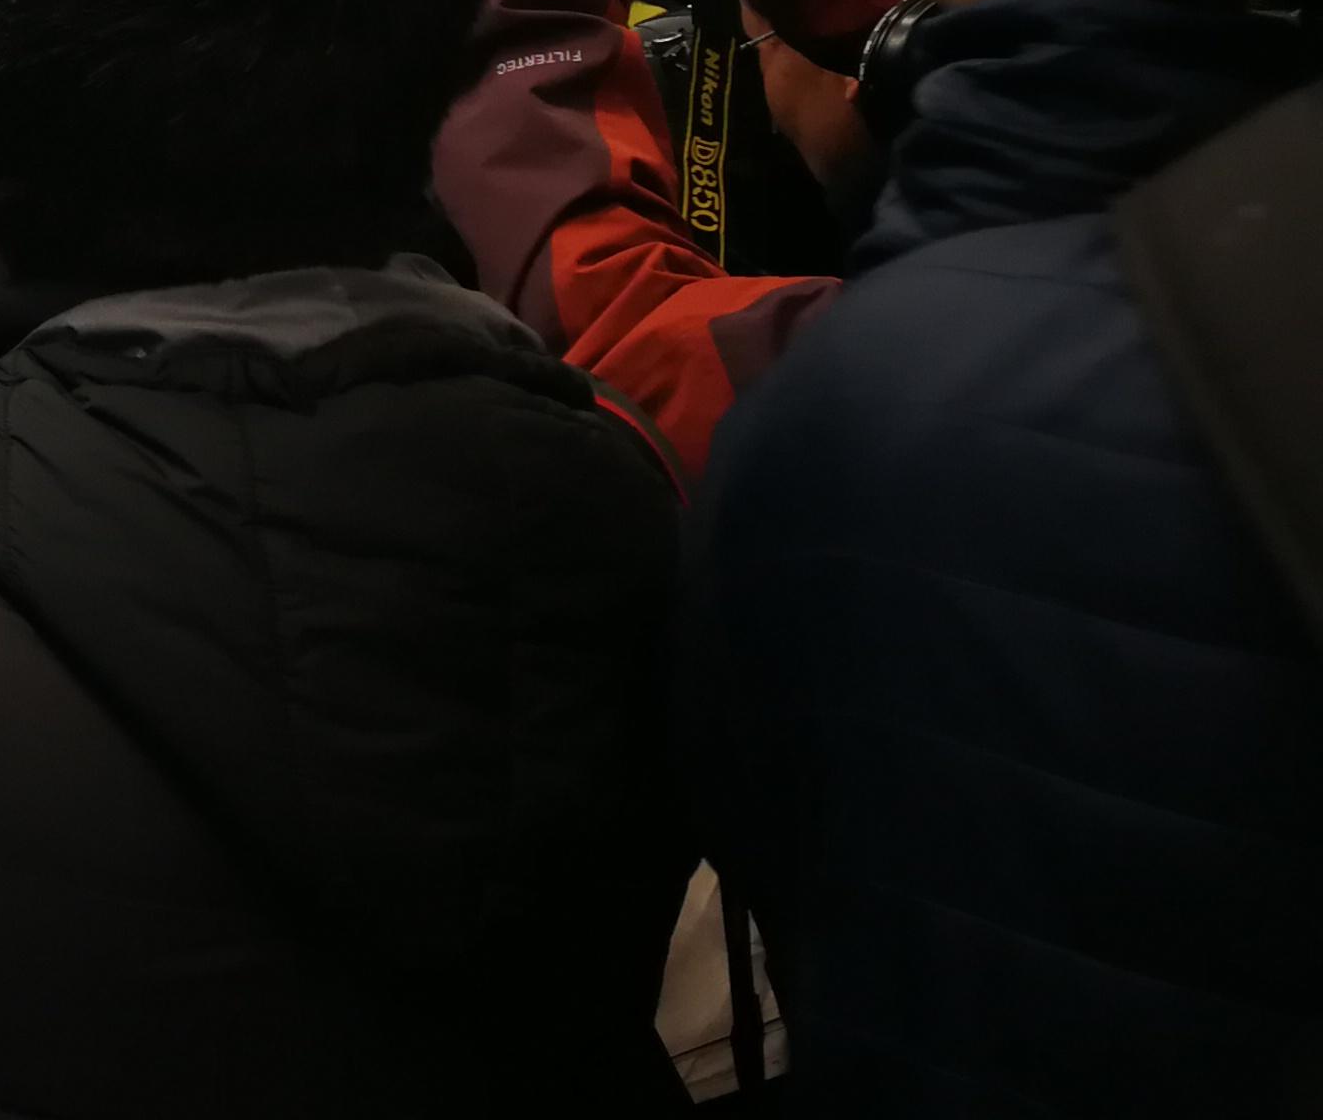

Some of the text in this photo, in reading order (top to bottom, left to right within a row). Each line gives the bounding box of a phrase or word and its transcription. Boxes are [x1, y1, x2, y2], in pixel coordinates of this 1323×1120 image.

[496, 49, 583, 76] FILTERTEC
[690, 48, 721, 232] Nikon D850
